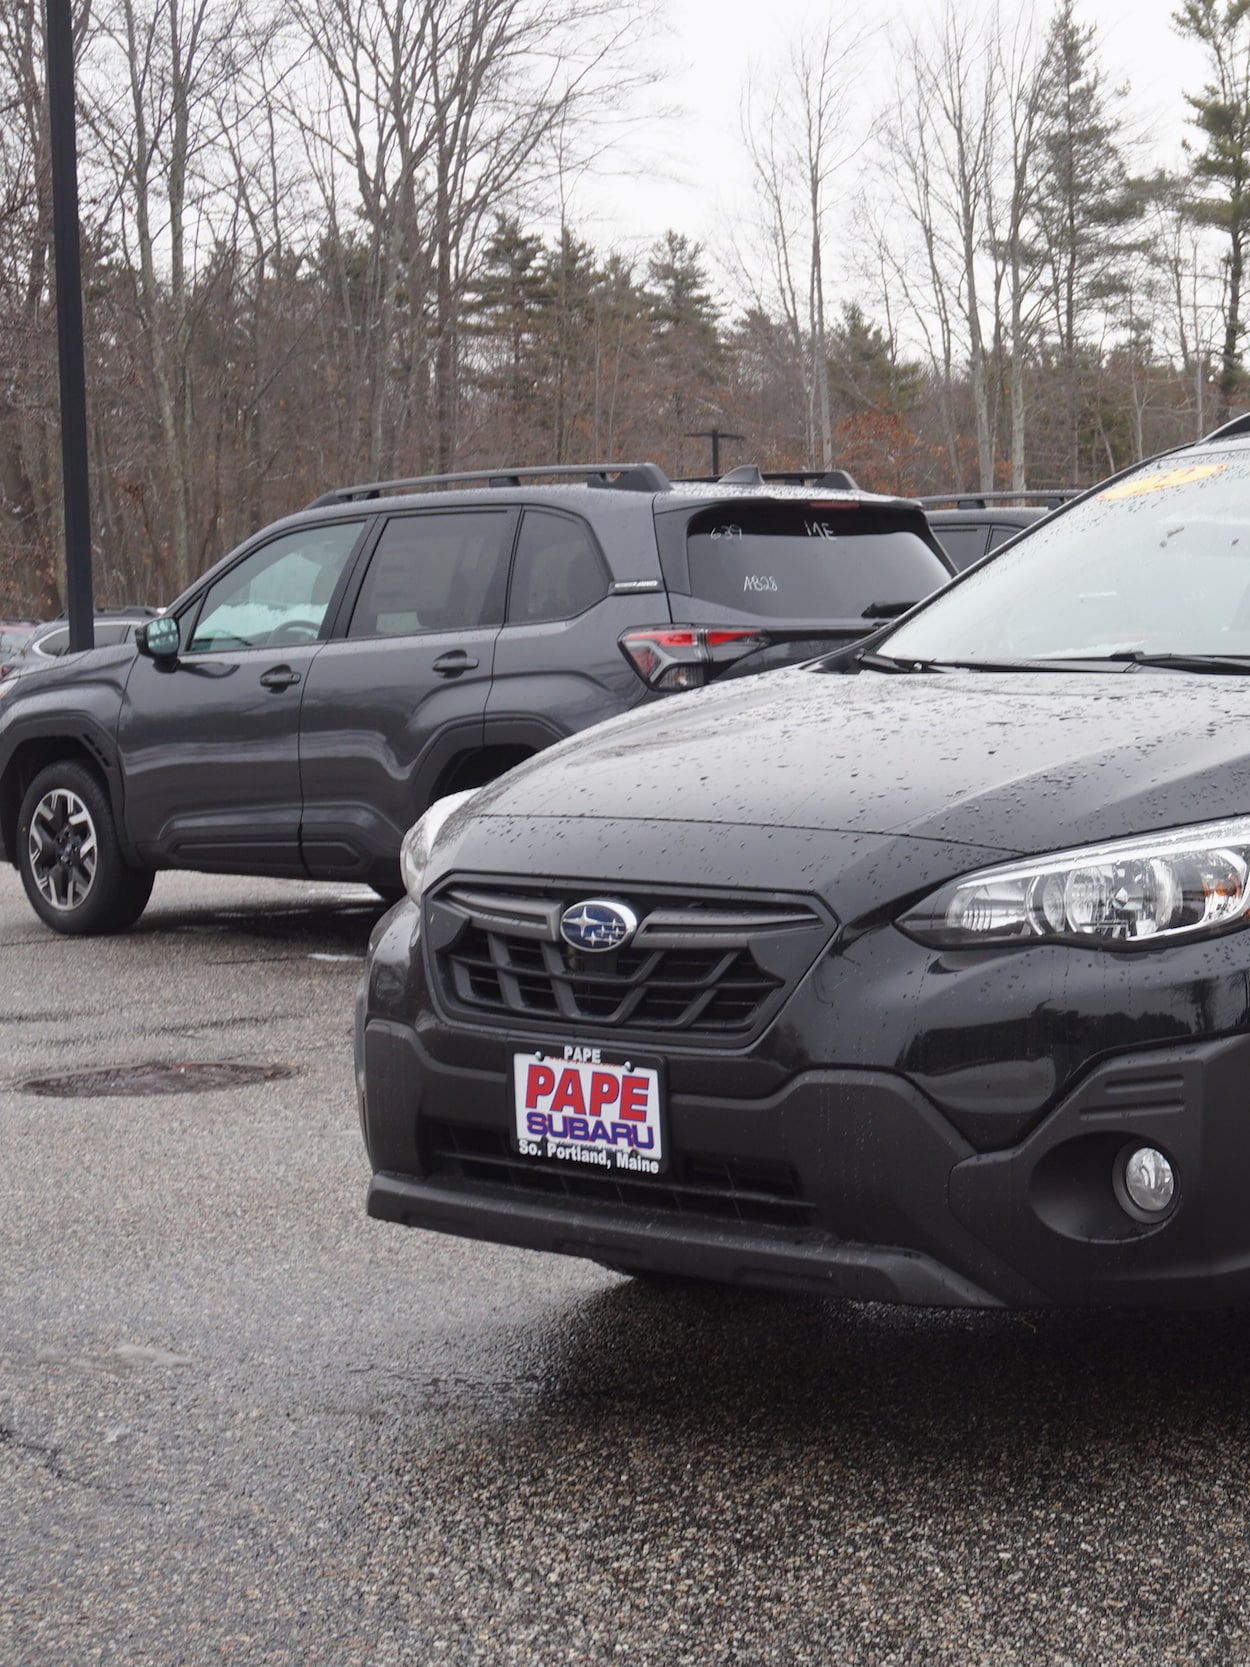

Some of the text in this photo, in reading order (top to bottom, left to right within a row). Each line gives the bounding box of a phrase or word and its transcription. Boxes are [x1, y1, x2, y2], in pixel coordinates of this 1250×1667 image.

[564, 1046, 602, 1062] PAPE
[526, 1064, 650, 1122] PAPE
[526, 1112, 654, 1149] SUBARU
[519, 1139, 542, 1156] So.
[547, 1143, 612, 1169] Portland,
[616, 1153, 659, 1174] Maine
